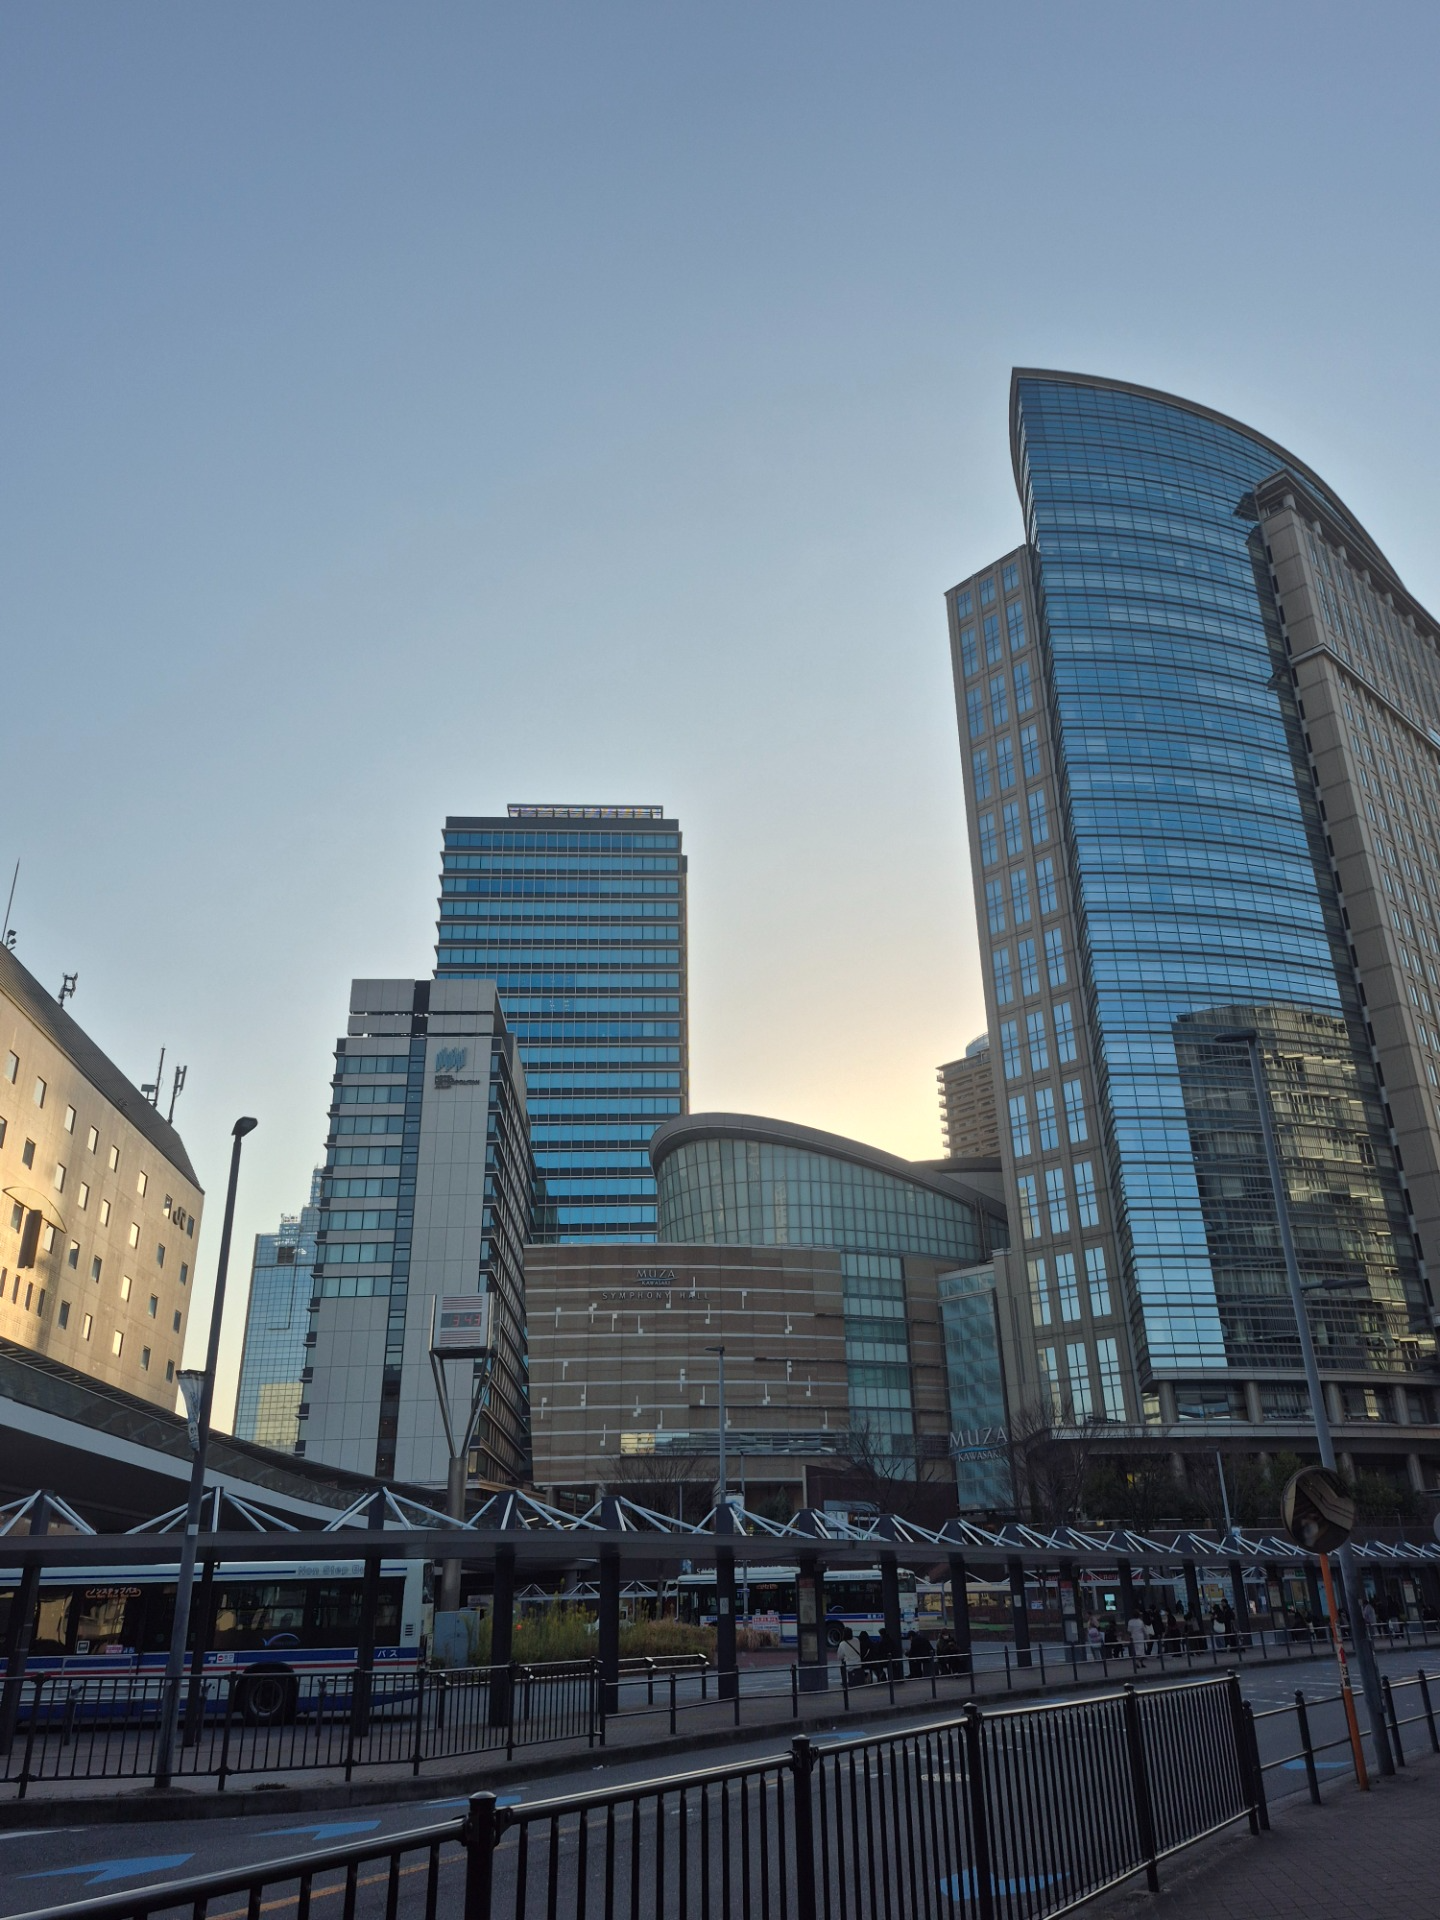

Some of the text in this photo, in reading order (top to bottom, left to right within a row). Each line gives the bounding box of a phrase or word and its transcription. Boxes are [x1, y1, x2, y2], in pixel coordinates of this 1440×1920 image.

[172, 1206, 187, 1231] JR
[636, 1268, 676, 1279] MUZA
[602, 1291, 710, 1300] SYMPHONY HALL
[949, 1425, 1009, 1448] MUZA
